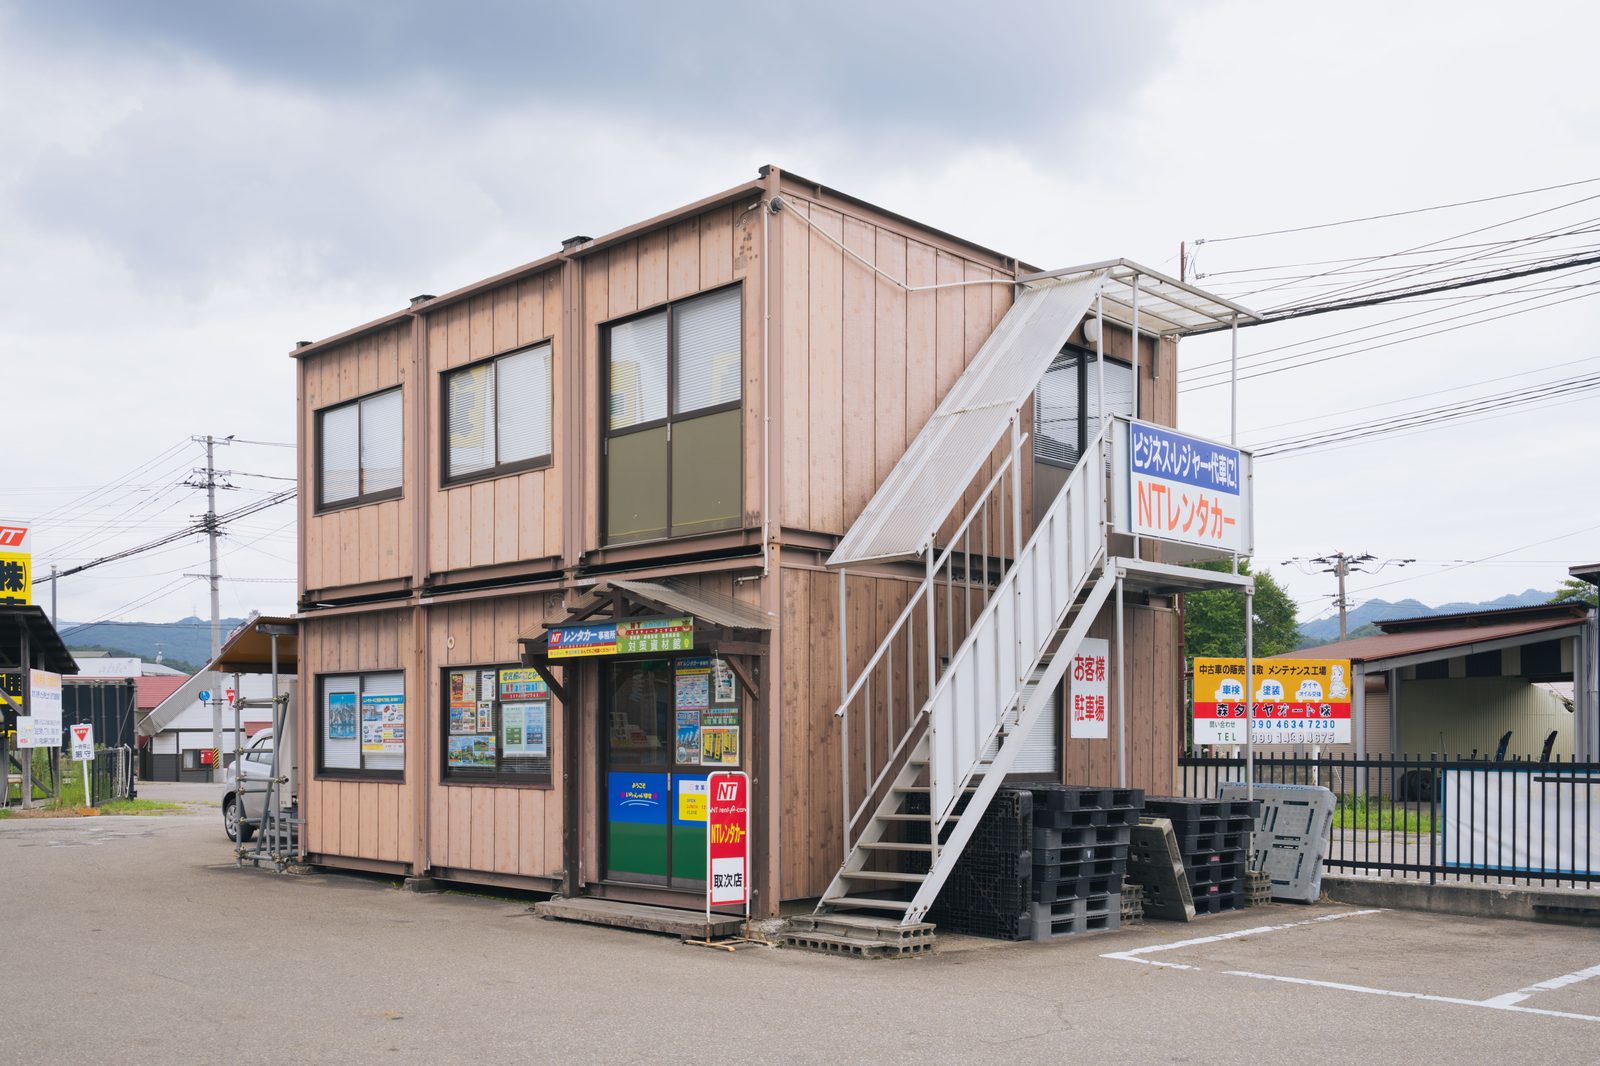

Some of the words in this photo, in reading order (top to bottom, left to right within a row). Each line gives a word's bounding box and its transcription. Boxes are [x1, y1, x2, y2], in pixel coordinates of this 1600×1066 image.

[1138, 481, 1236, 540] NTレンタカー
[550, 632, 562, 643] NT
[563, 629, 597, 643] レンタカー
[1074, 653, 1105, 682] お客様
[1268, 665, 1327, 676] メンテナンス工場
[1222, 685, 1240, 695] 車検
[1262, 685, 1280, 696] 塗装
[1074, 694, 1105, 722] 駐車場
[1276, 719, 1304, 729] 4634
[1308, 719, 1336, 729] 7230
[1217, 732, 1237, 742] TEL
[717, 782, 738, 801] NT
[711, 823, 746, 844] NTレンタカー
[713, 873, 743, 888] 取次店
